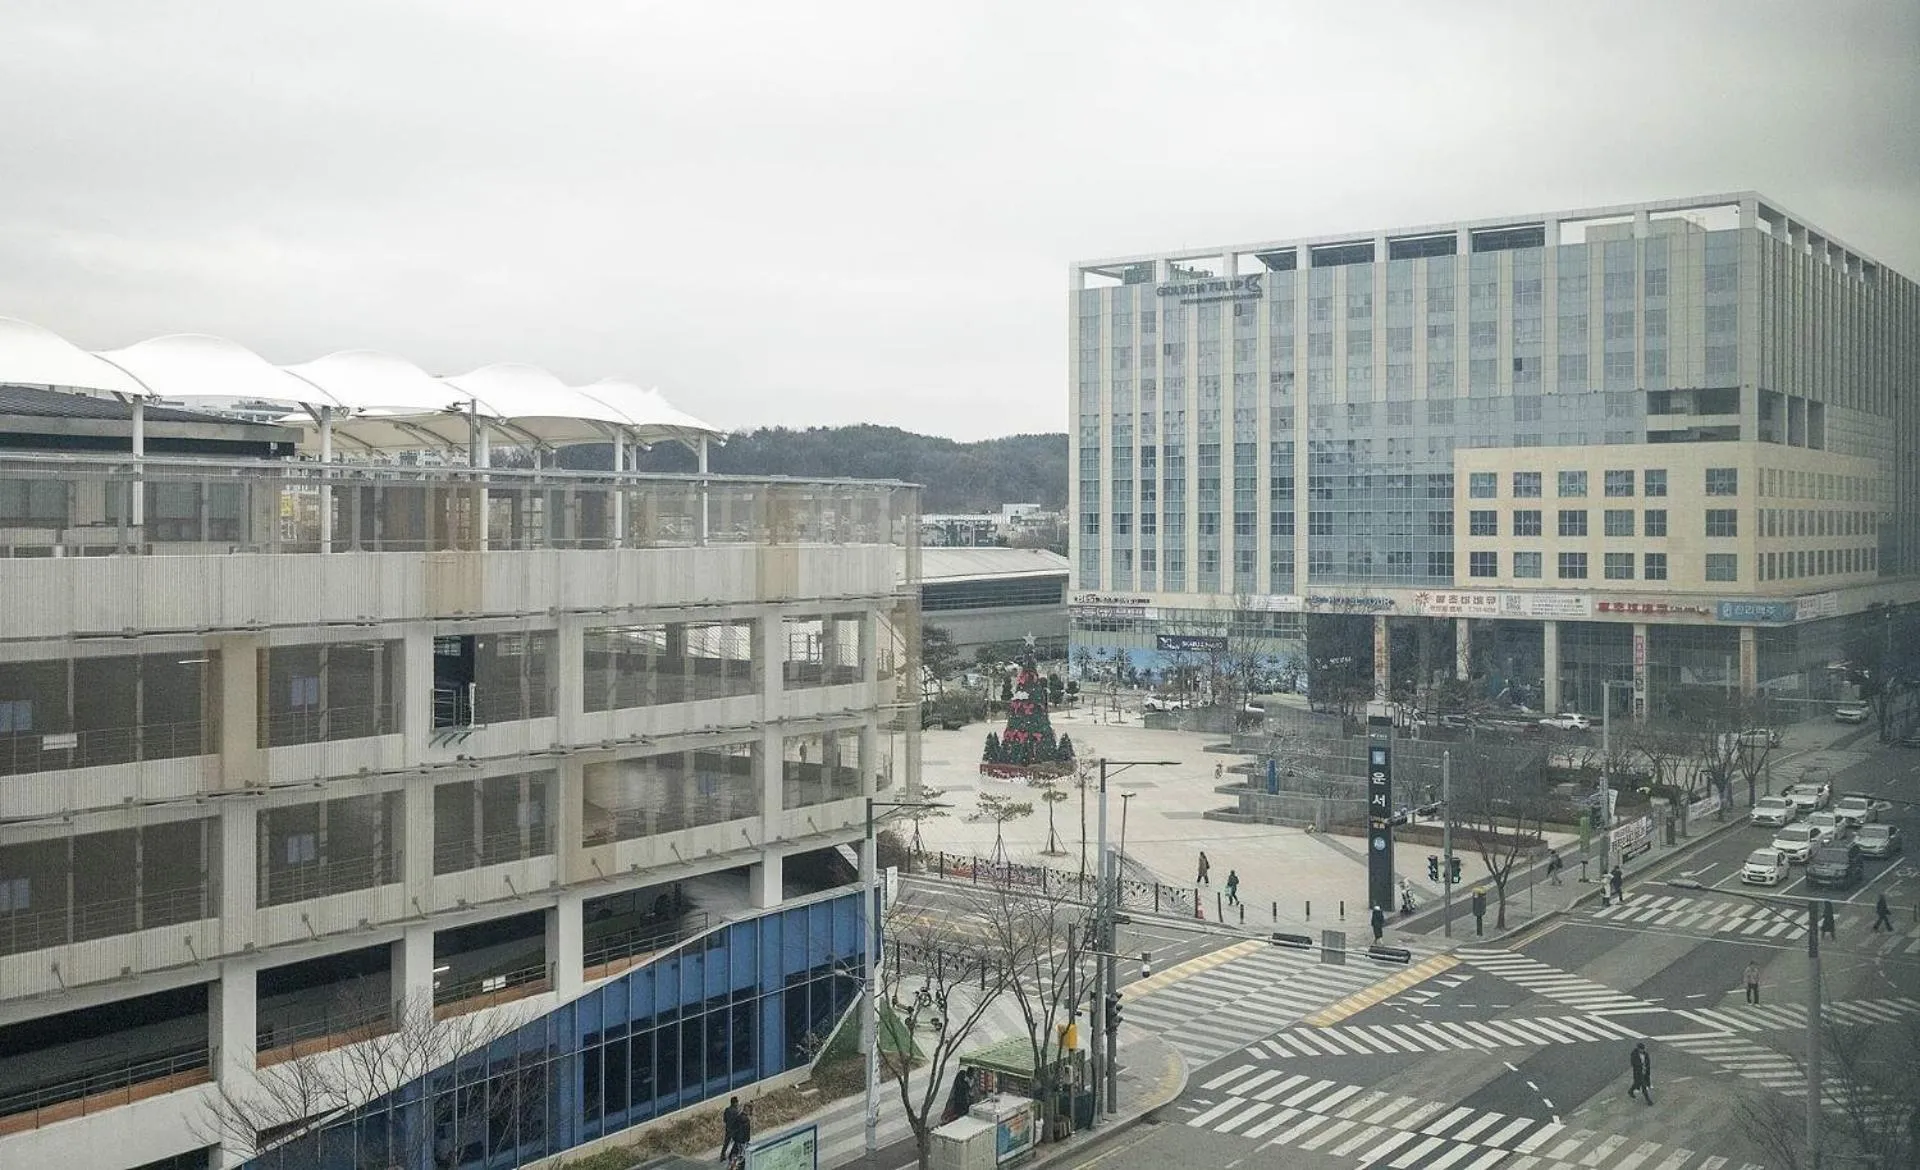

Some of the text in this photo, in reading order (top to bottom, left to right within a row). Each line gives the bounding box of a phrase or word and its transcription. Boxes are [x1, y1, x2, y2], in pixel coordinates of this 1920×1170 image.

[1156, 280, 1243, 297] GOLDEN TULIP
[1372, 772, 1386, 807] 운서
